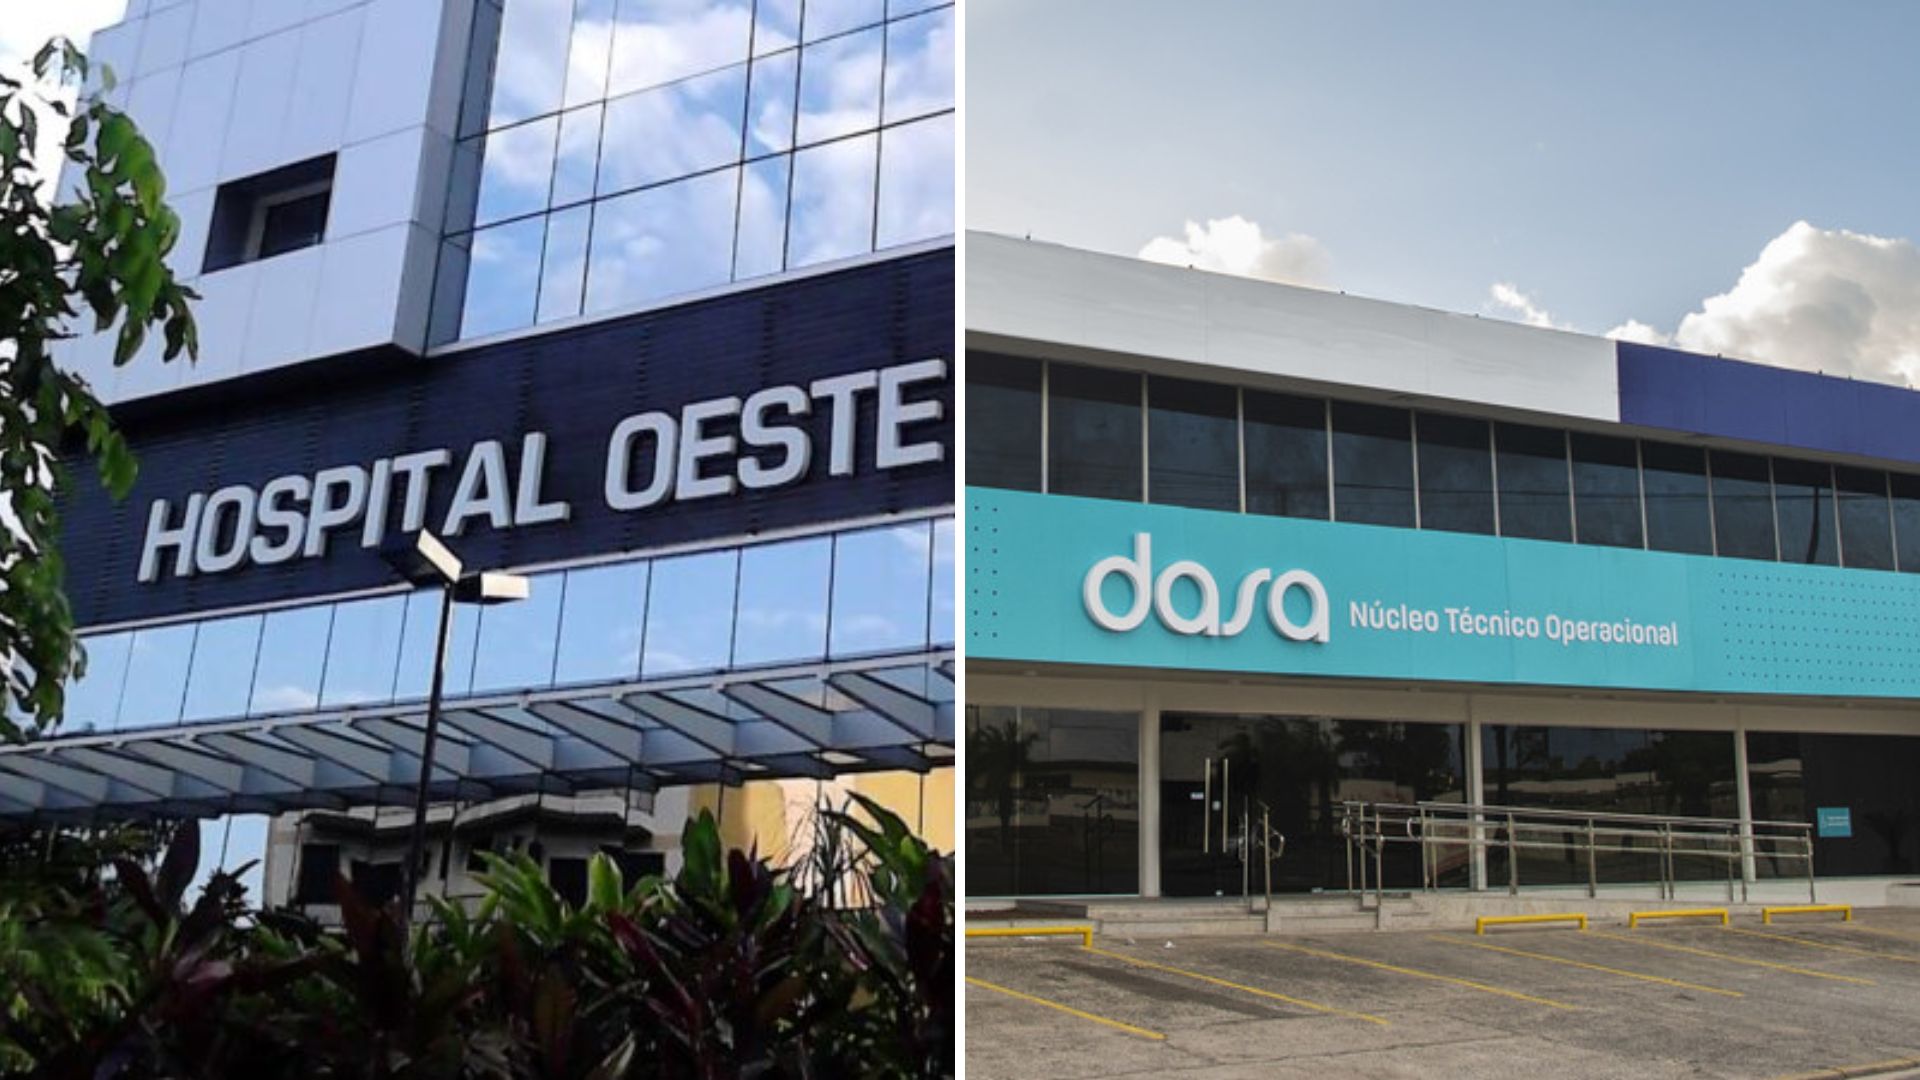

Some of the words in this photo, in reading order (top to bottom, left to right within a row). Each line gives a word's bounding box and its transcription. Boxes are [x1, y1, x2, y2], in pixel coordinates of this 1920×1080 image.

[138, 432, 569, 583] HOSPITAL
[605, 358, 946, 512] OESTE
[1083, 532, 1330, 643] dasa
[1349, 600, 1439, 632] Núcleo
[1446, 606, 1540, 638] Técnico
[1545, 614, 1679, 646] Operacional
